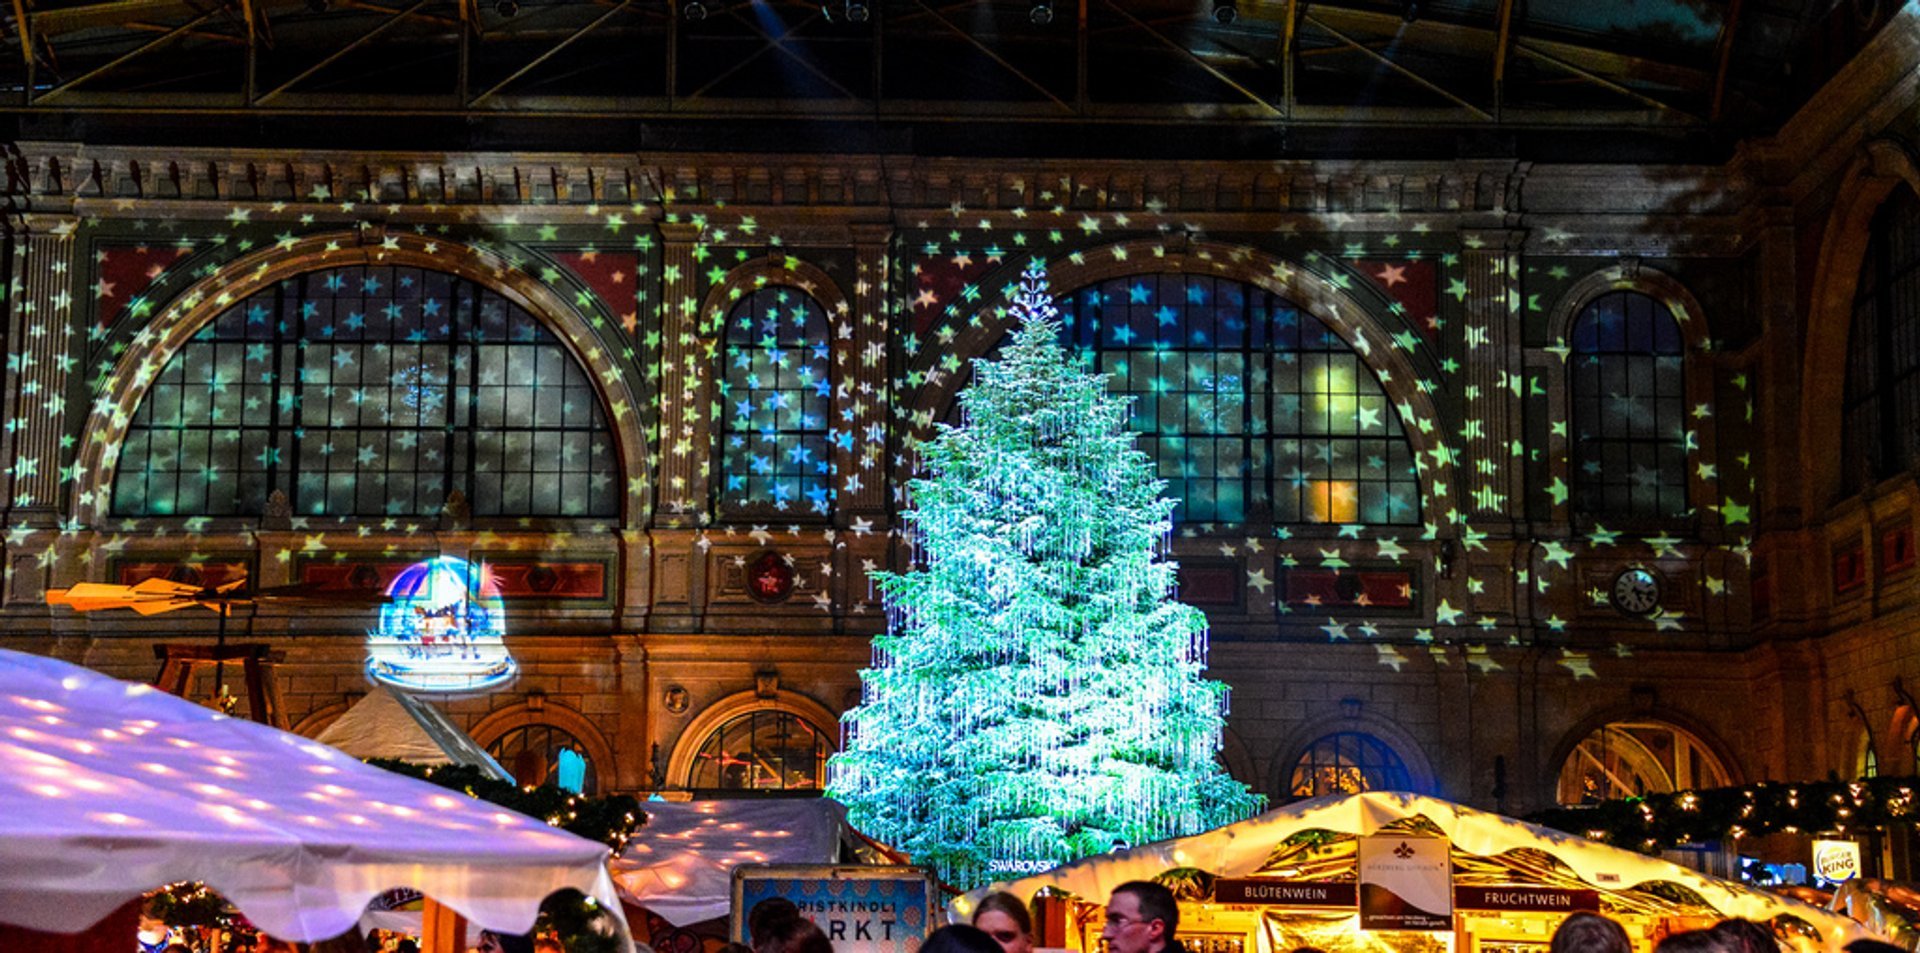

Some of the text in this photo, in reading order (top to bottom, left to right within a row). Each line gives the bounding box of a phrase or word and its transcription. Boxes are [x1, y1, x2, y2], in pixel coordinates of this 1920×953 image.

[1821, 859, 1854, 874] KING
[1244, 885, 1327, 899] BLÜTENWEIN
[1484, 892, 1571, 906] FRUCHTWEIN
[799, 901, 897, 913] RISTKINDLI
